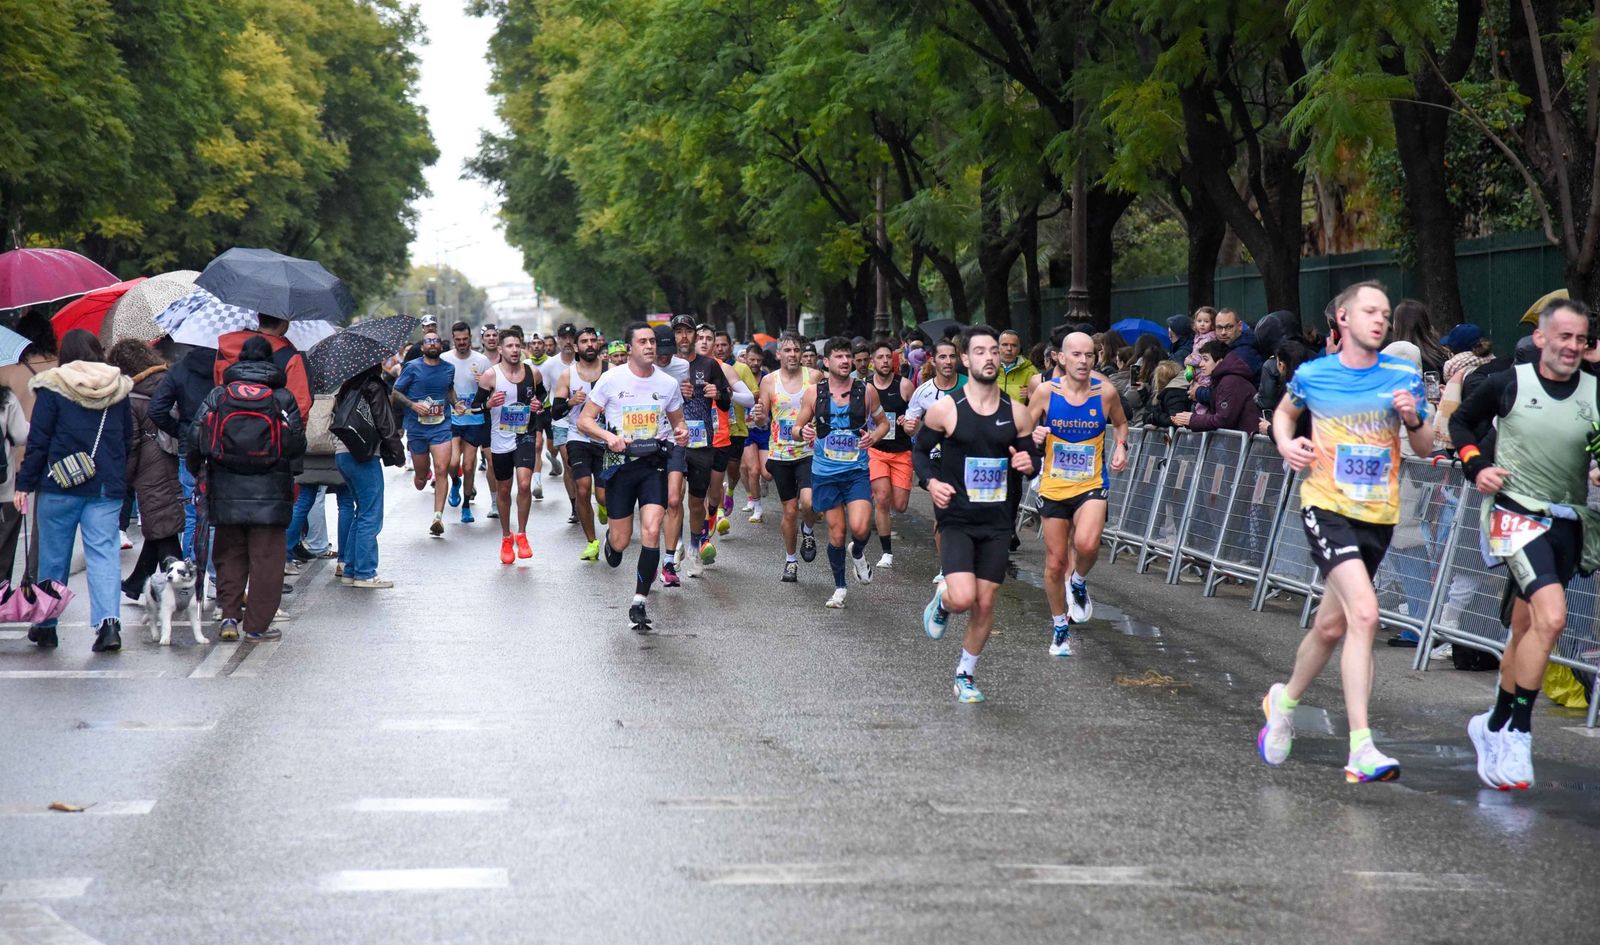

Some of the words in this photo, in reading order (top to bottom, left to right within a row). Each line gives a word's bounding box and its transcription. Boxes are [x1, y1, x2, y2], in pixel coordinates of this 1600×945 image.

[504, 413, 525, 422] 3573
[625, 413, 656, 425] 18816
[1051, 418, 1100, 430] agustinos
[830, 436, 854, 447] 3448
[1059, 452, 1086, 466] 2185
[1344, 458, 1381, 476] 3382
[972, 469, 1002, 483] 2330
